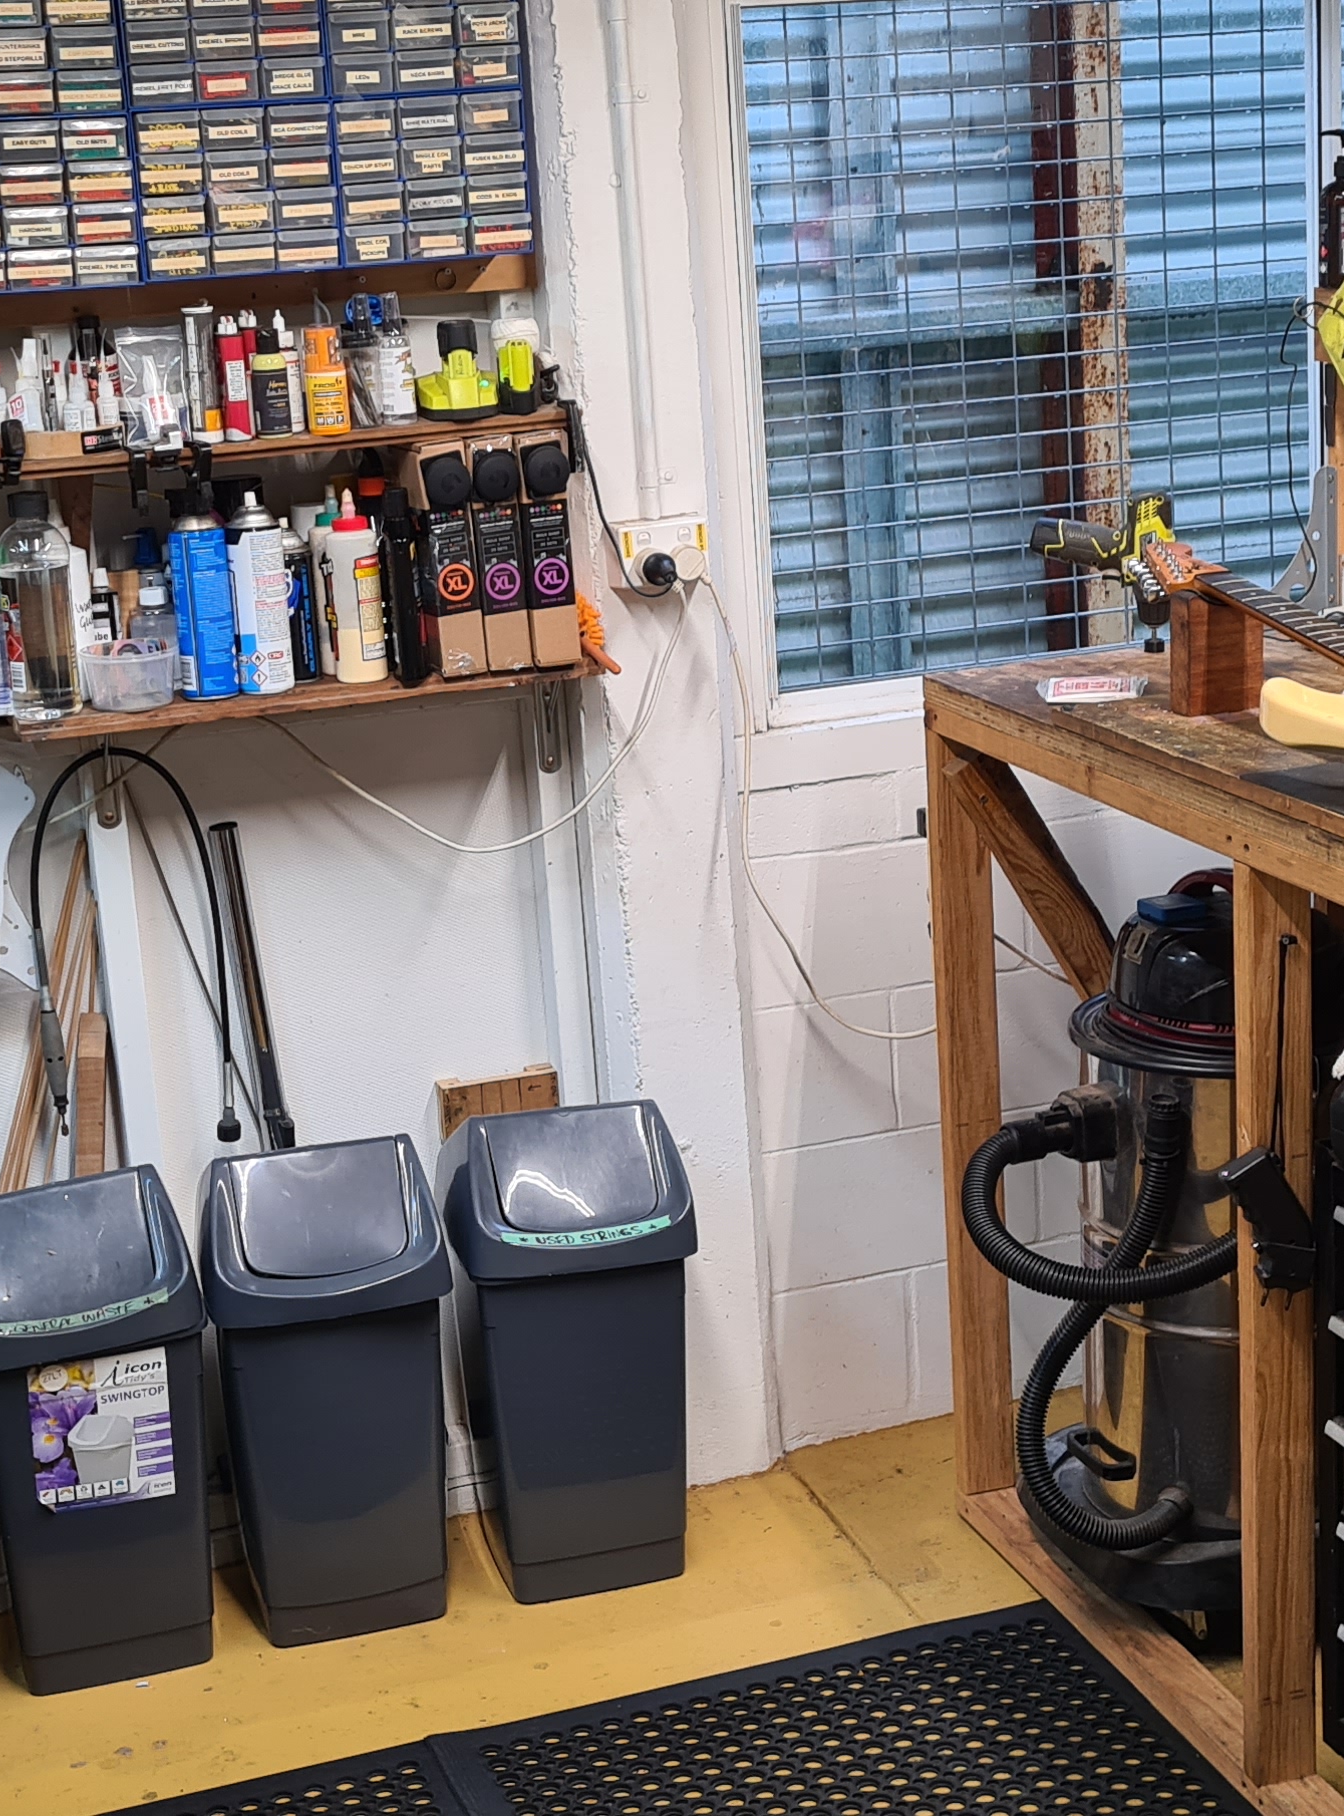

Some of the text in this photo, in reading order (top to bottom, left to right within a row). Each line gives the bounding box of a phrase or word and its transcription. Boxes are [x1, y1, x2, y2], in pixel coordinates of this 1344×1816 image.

[447, 575, 467, 591] XL
[493, 574, 514, 591] XL
[541, 570, 563, 586] XL
[535, 1225, 644, 1246] USED STRINGS
[82, 1302, 137, 1322] WASTE
[124, 1360, 162, 1375] icon
[125, 1372, 155, 1385] Tidy's
[100, 1386, 166, 1405] SWINGTOP
